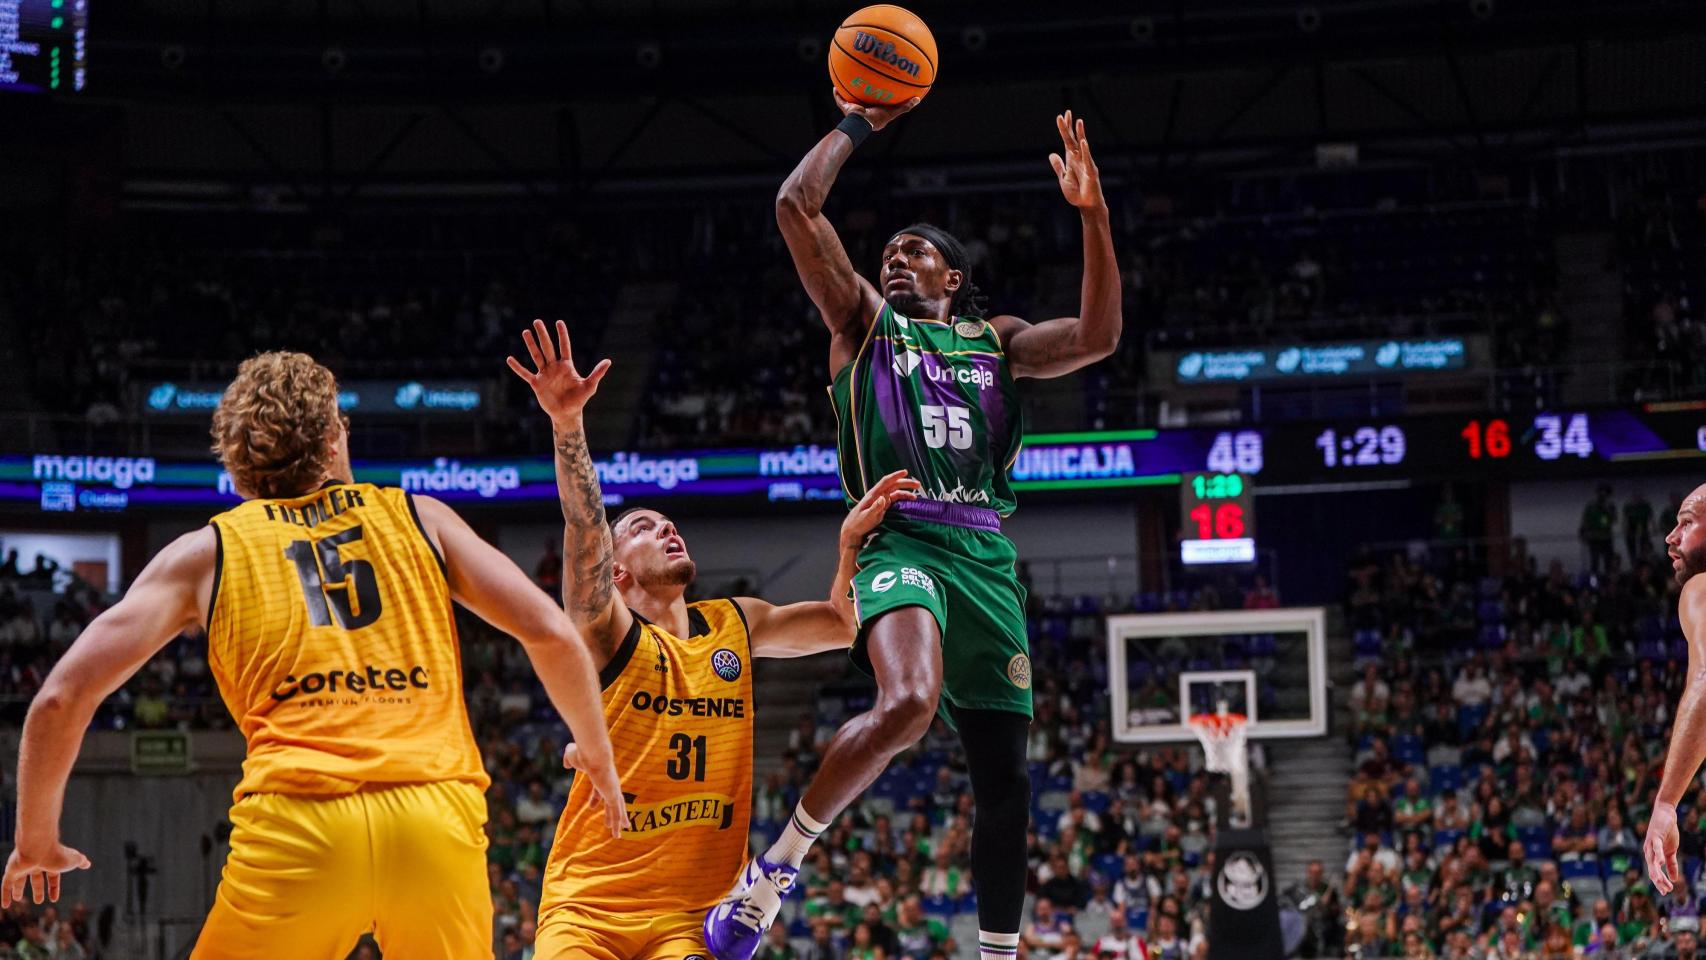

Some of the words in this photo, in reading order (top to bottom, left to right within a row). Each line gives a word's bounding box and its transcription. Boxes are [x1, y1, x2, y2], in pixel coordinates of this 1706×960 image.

[853, 31, 920, 78] Wilson
[925, 363, 994, 391] Uncaja
[920, 404, 973, 450] 55
[1206, 430, 1264, 475] 48
[1315, 424, 1406, 468] 1:29
[1461, 419, 1512, 459] 16
[1534, 413, 1593, 460] 34
[1012, 444, 1136, 480] UNICAJA
[262, 487, 366, 529] FIEDLER
[1190, 503, 1245, 541] 16
[283, 524, 383, 632] 15
[271, 666, 429, 702] coretec
[632, 691, 745, 719] OOSTENDE
[667, 732, 707, 783] 31
[622, 799, 721, 833] KASTEEL
